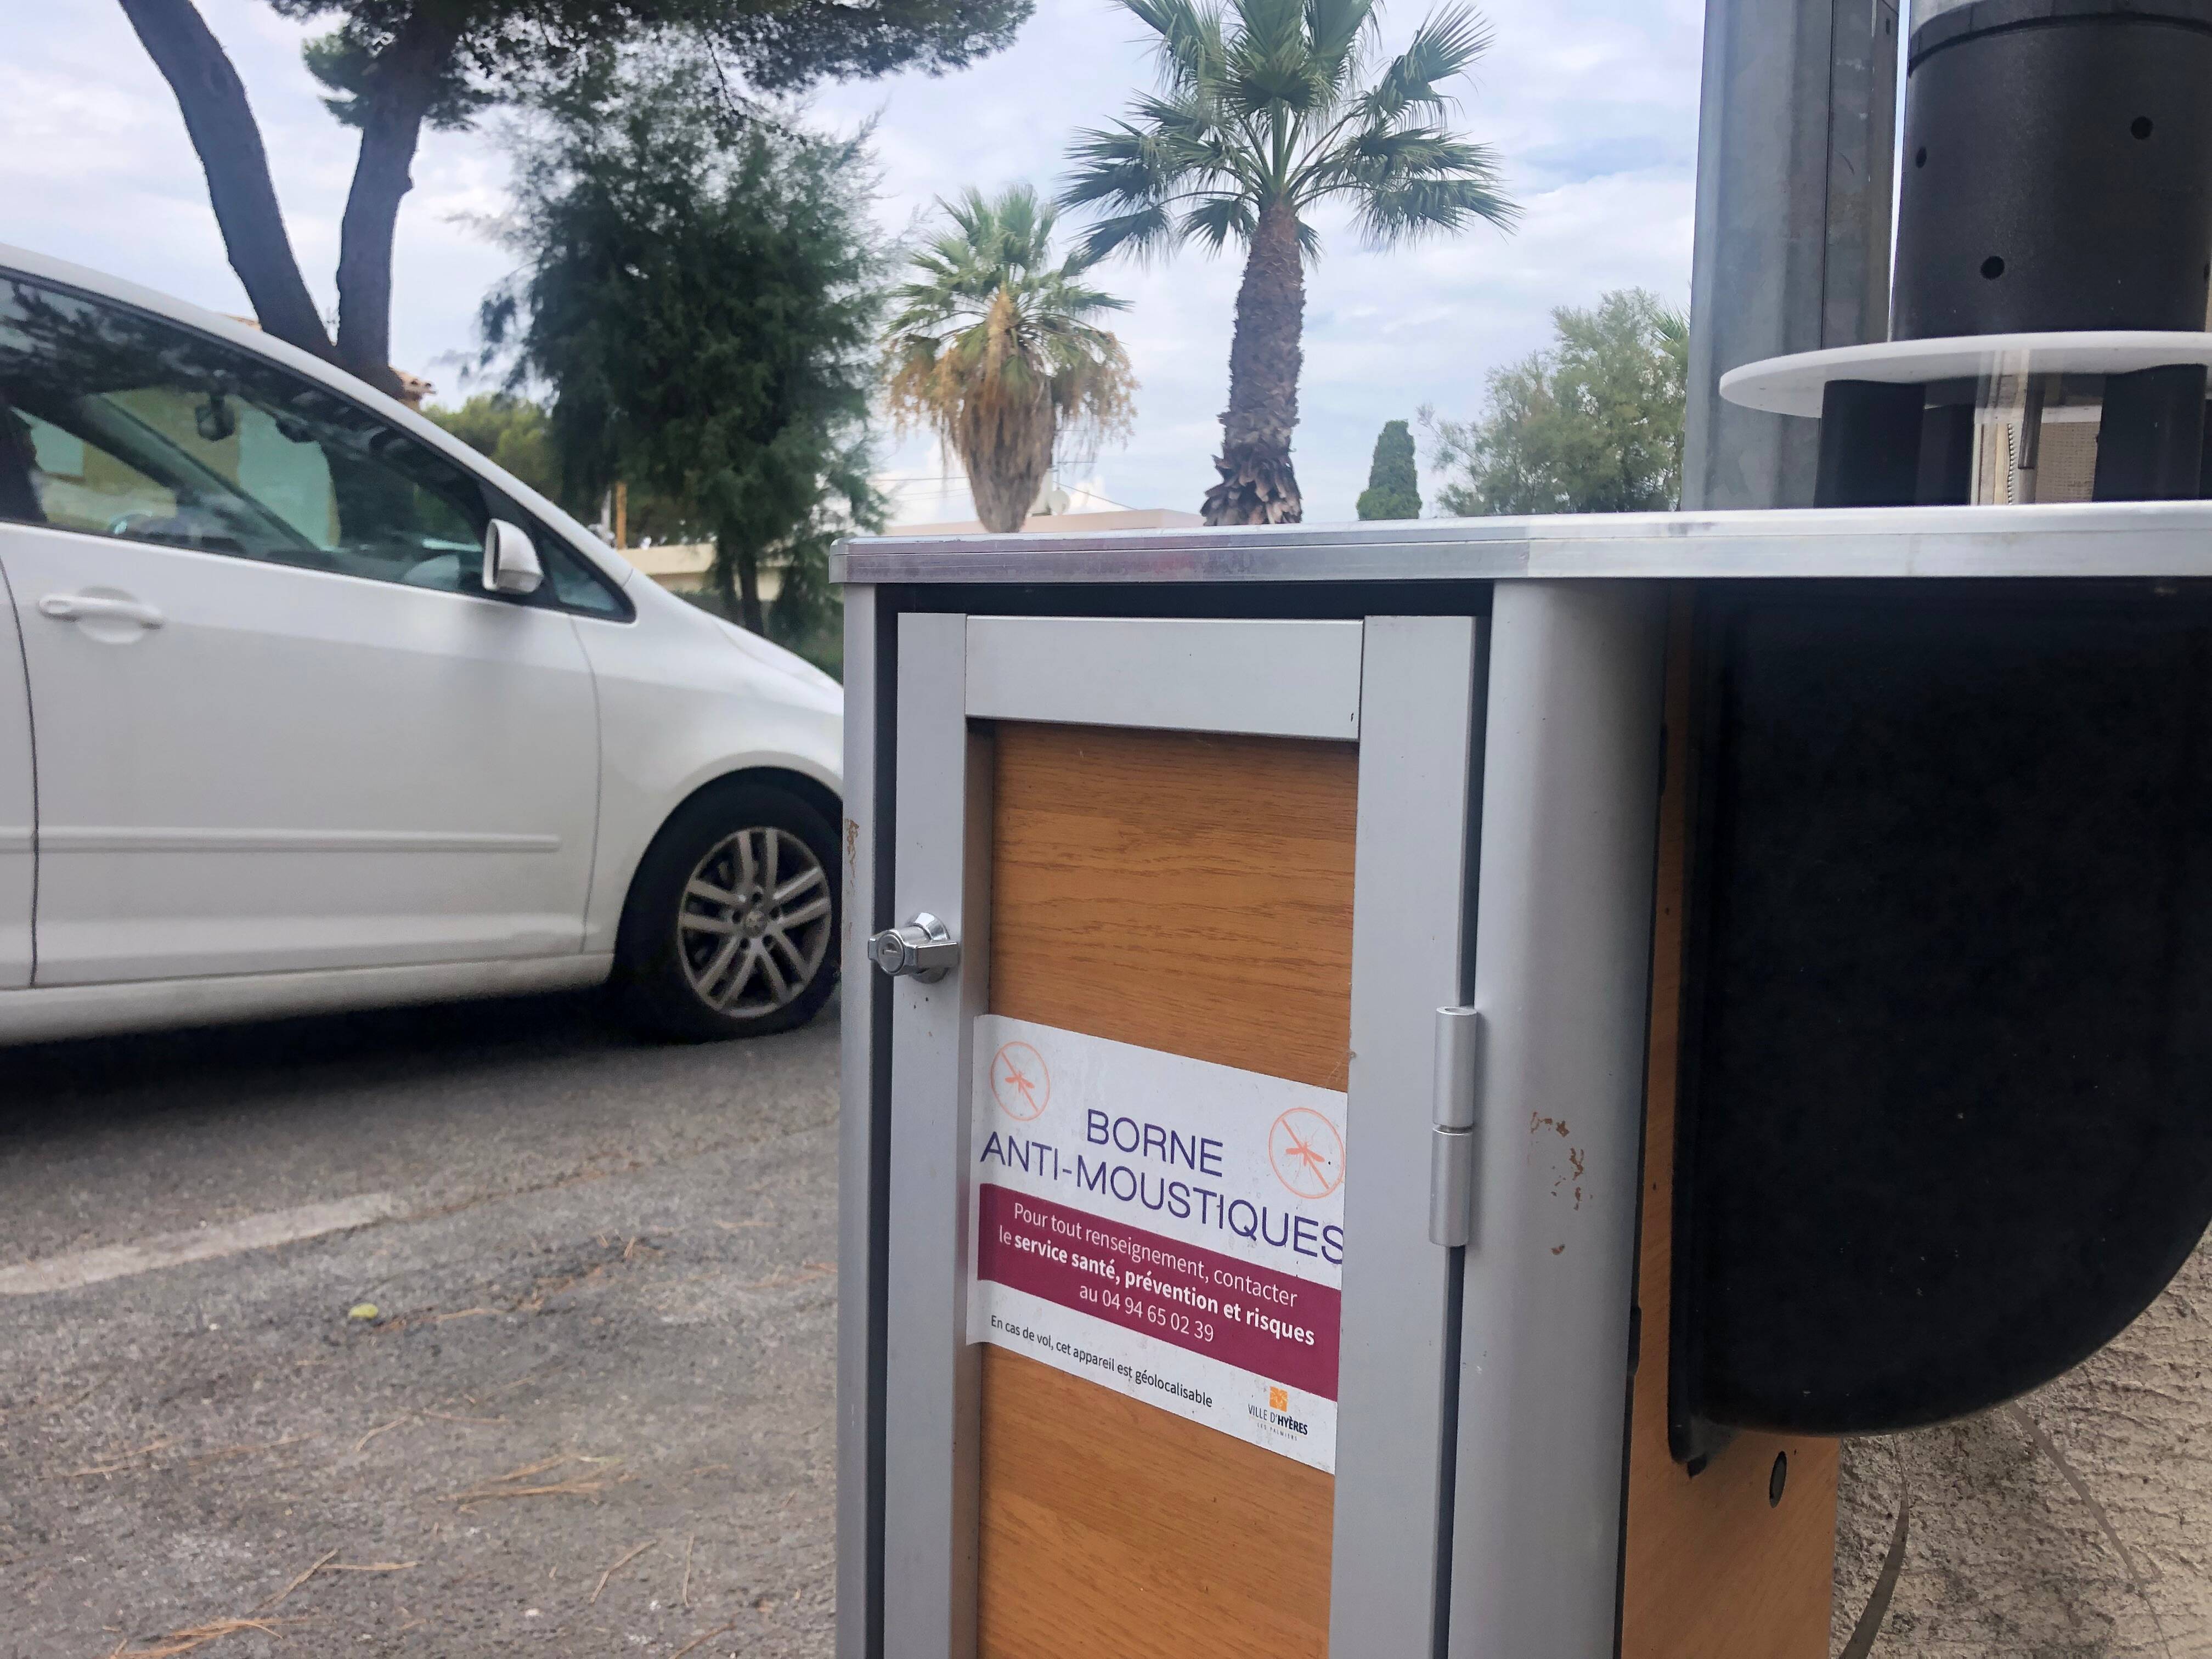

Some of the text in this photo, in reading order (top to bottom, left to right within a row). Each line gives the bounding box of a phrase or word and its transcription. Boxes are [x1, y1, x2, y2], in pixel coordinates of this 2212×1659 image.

[1087, 1109, 1223, 1177] BORNE
[980, 1131, 1343, 1265] ANTI-MOUSTIQUES
[999, 1225, 1314, 1345] le service santé, prévention et risques
[1014, 1203, 1298, 1307] Pour tout renseignement, contacter
[1080, 1285, 1214, 1342] au 04 94 65 02 39
[991, 1315, 1212, 1408] En cas de vol, cet appareil est géolocalisable
[1248, 1404, 1308, 1435] VILLE D'HYÈRES
